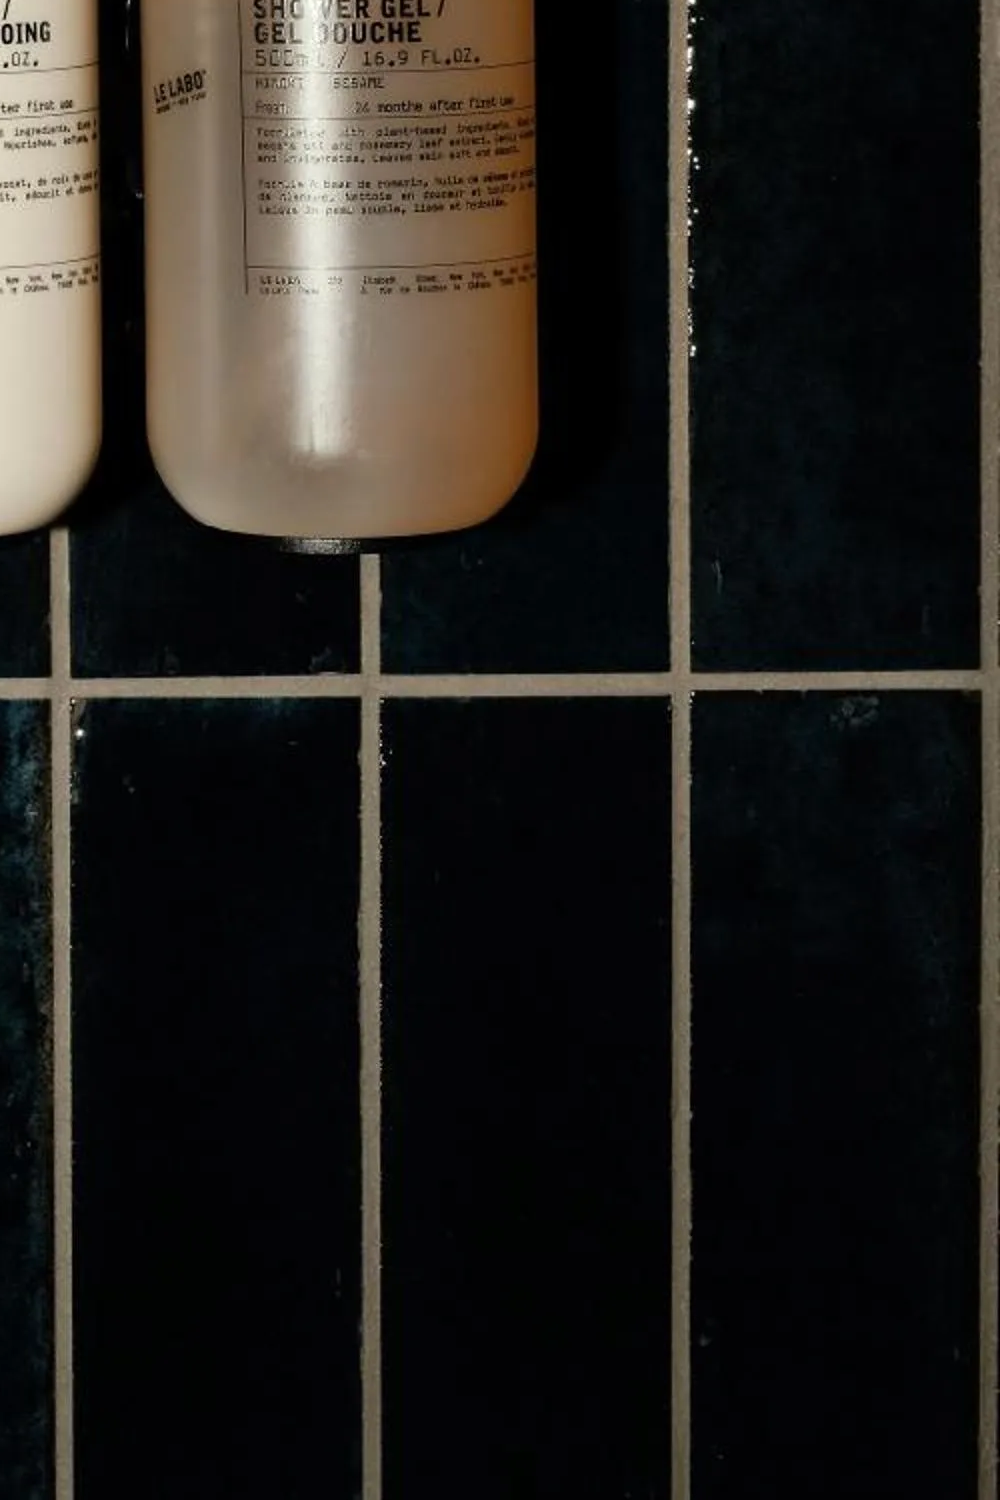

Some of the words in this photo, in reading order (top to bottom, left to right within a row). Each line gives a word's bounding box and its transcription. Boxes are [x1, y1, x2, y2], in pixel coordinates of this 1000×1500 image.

[254, 21, 303, 45] GEL
[318, 20, 423, 45] DOUCHE
[361, 51, 409, 68] 16.9
[421, 47, 481, 66] FL.OZ.
[153, 83, 167, 104] LE
[168, 70, 203, 98] LABO
[27, 99, 55, 113] first
